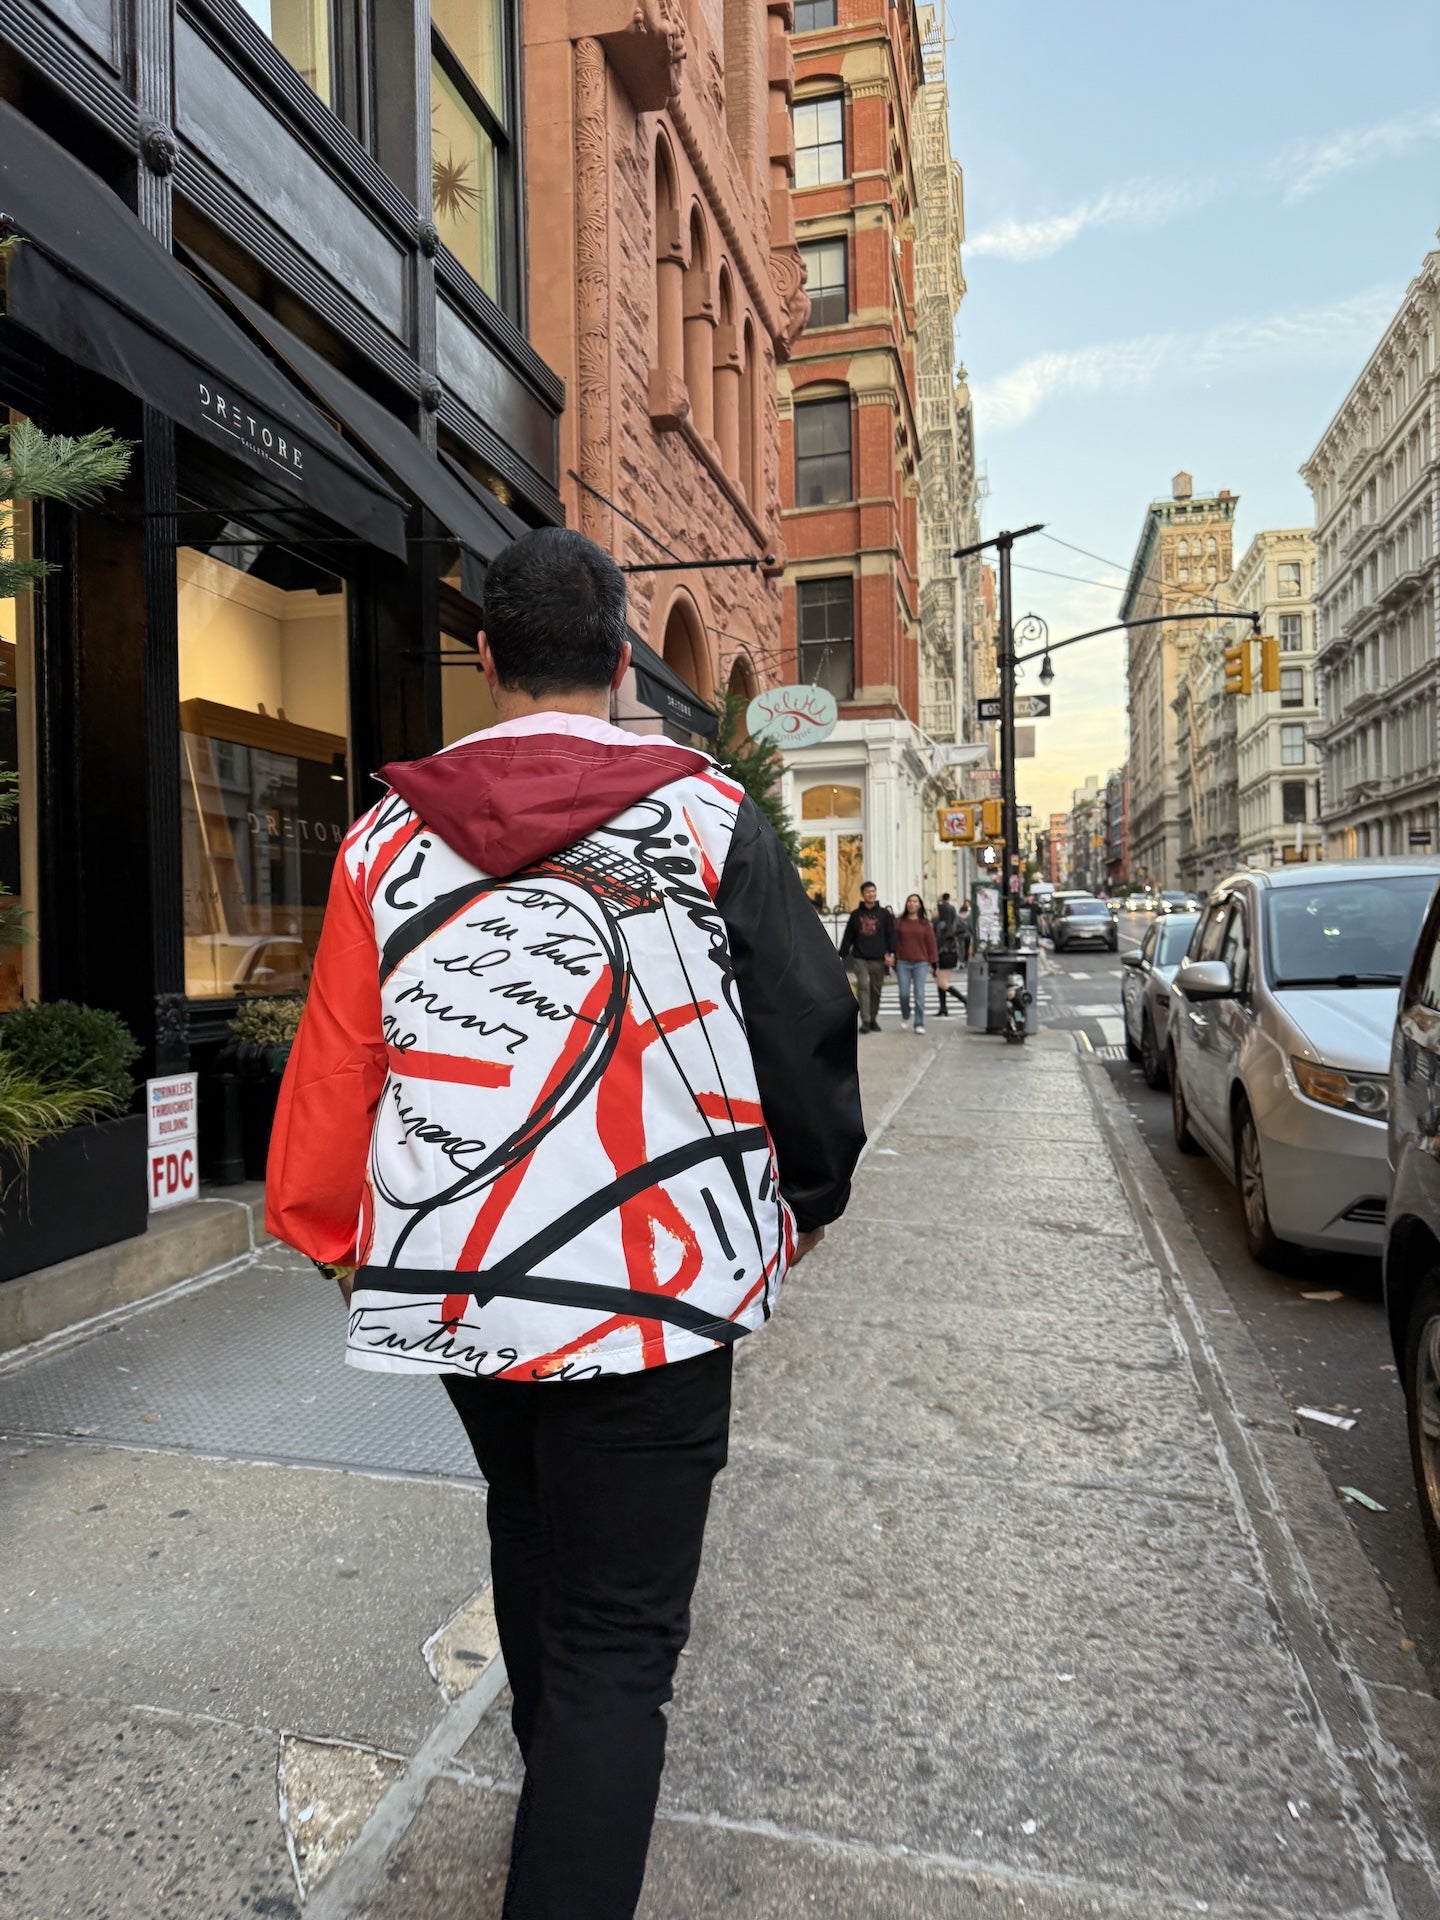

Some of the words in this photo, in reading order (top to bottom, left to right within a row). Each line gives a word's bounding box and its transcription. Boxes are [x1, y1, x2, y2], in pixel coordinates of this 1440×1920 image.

[199, 383, 303, 469] DRETORE
[1018, 702, 1040, 713] WAY
[248, 812, 343, 843] DRETOR
[152, 1098, 194, 1118] THROUGHOUT
[159, 1116, 188, 1134] BUILDING
[152, 1149, 194, 1198] FDC
